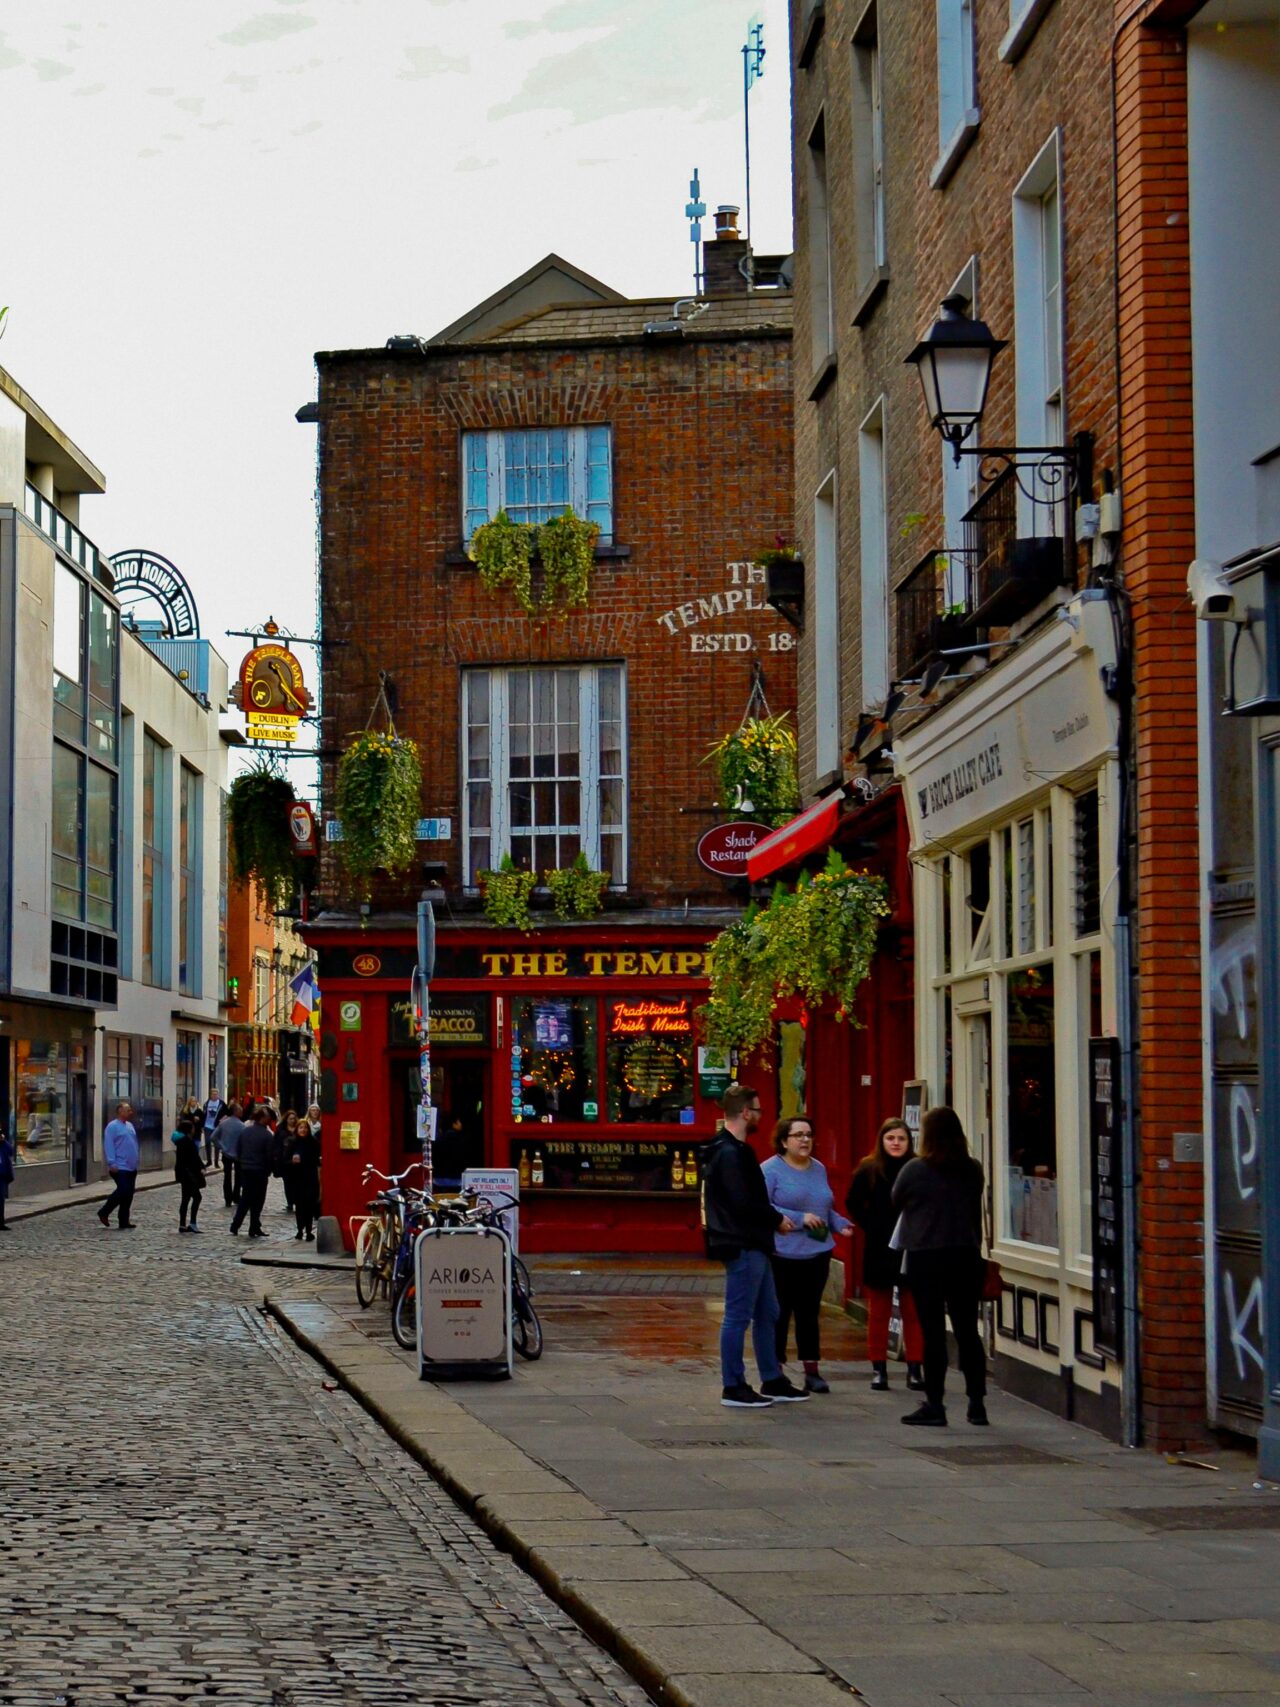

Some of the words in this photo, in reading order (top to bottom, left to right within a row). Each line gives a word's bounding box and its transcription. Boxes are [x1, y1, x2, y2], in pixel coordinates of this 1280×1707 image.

[726, 562, 766, 584] TH
[656, 589, 776, 635] TEMPL
[690, 633, 757, 653] ESTD.
[767, 632, 797, 652] 18
[246, 658, 257, 684] THE
[254, 648, 292, 664] TEMPLE
[291, 663, 302, 688] BAR
[258, 714, 290, 724] DUBLIN
[252, 728, 270, 738] LIVE
[271, 729, 296, 739] MUSIC
[929, 773, 954, 814] BRICK
[953, 758, 978, 800] ALLEY
[725, 831, 757, 848] Shack
[358, 958, 376, 971] 48
[482, 952, 568, 976] THE
[614, 1000, 687, 1018] Traditional
[403, 1012, 476, 1037] TBACCO
[612, 1017, 646, 1032] Irish
[651, 1017, 690, 1032] Music
[545, 1142, 575, 1155] THE
[578, 1142, 635, 1156] TEMPLE
[639, 1143, 667, 1156] BAR
[428, 1267, 495, 1284] ARIOSA
